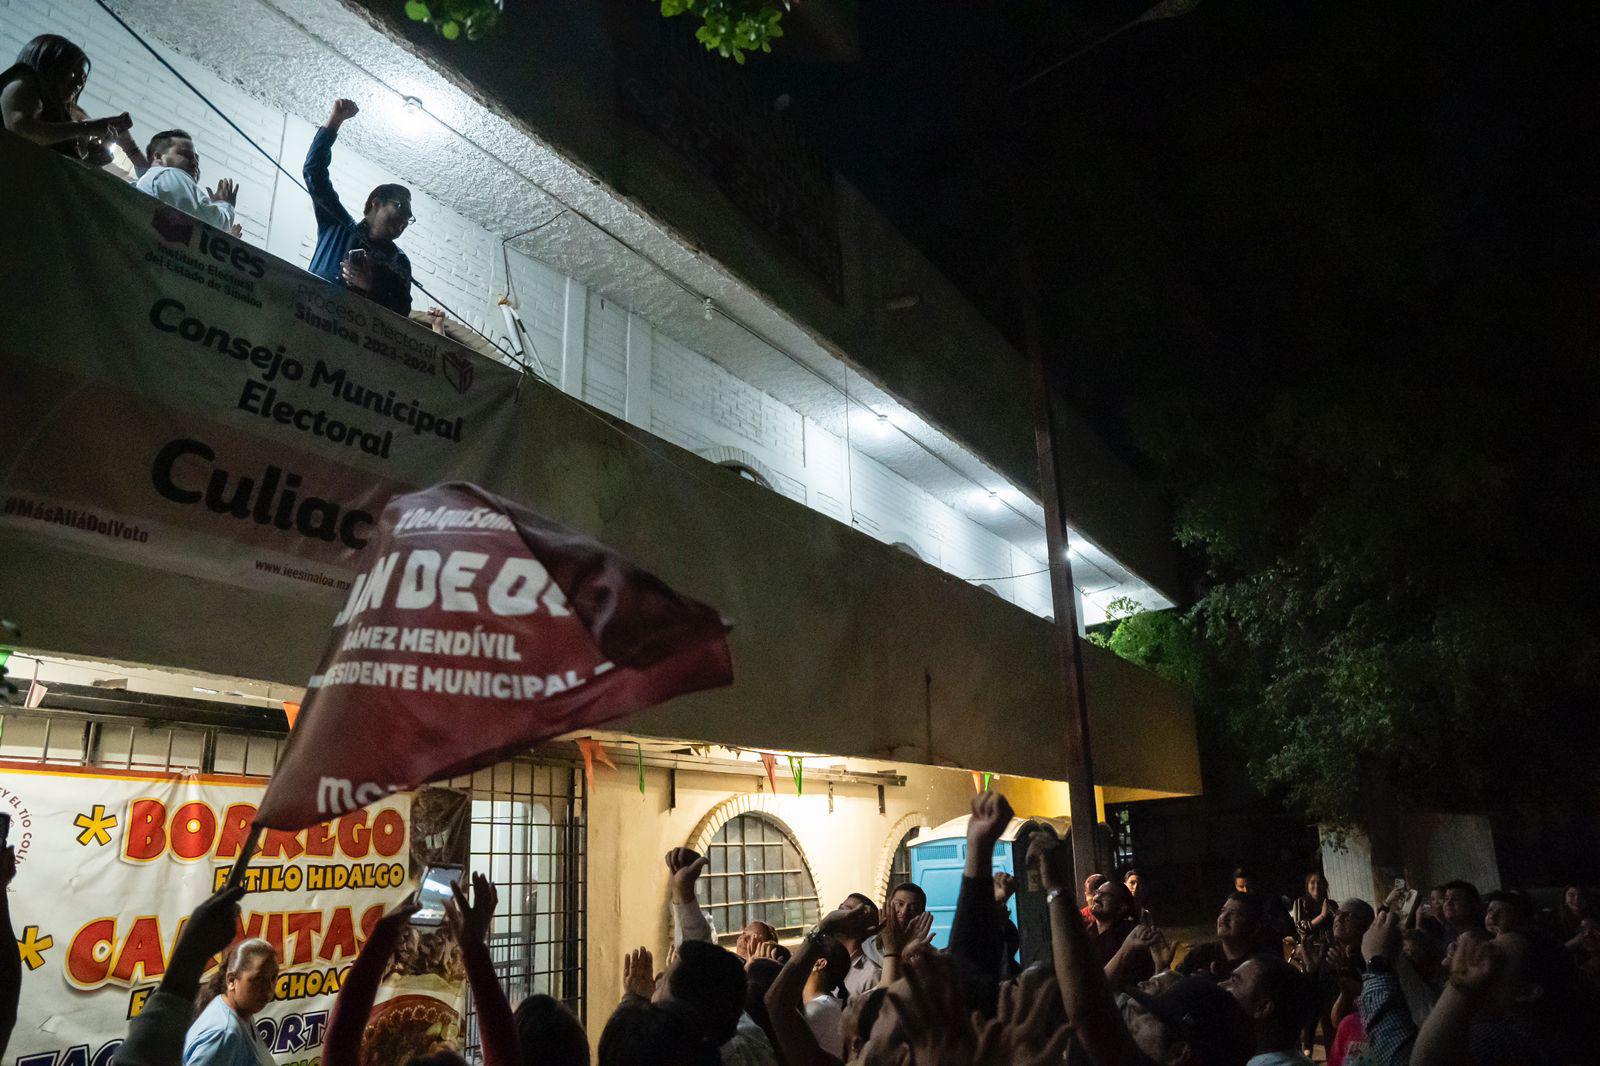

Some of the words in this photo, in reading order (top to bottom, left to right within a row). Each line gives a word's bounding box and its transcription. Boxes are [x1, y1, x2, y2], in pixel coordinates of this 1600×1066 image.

[199, 222, 265, 279] iees
[294, 302, 360, 345] Sinaloa
[363, 335, 436, 377] 2023-2024
[297, 283, 367, 329] Proceso
[371, 317, 438, 359] Electoral
[150, 298, 304, 382] Consejo
[309, 360, 464, 443] Municipal
[238, 378, 393, 459] Electoral
[152, 438, 375, 550] Culiac
[396, 549, 490, 613] DE
[400, 625, 522, 661] MENDÍVIL
[421, 664, 587, 700] MUNICIPAL
[212, 864, 303, 894] ETILO
[306, 863, 405, 892] HIDALGO
